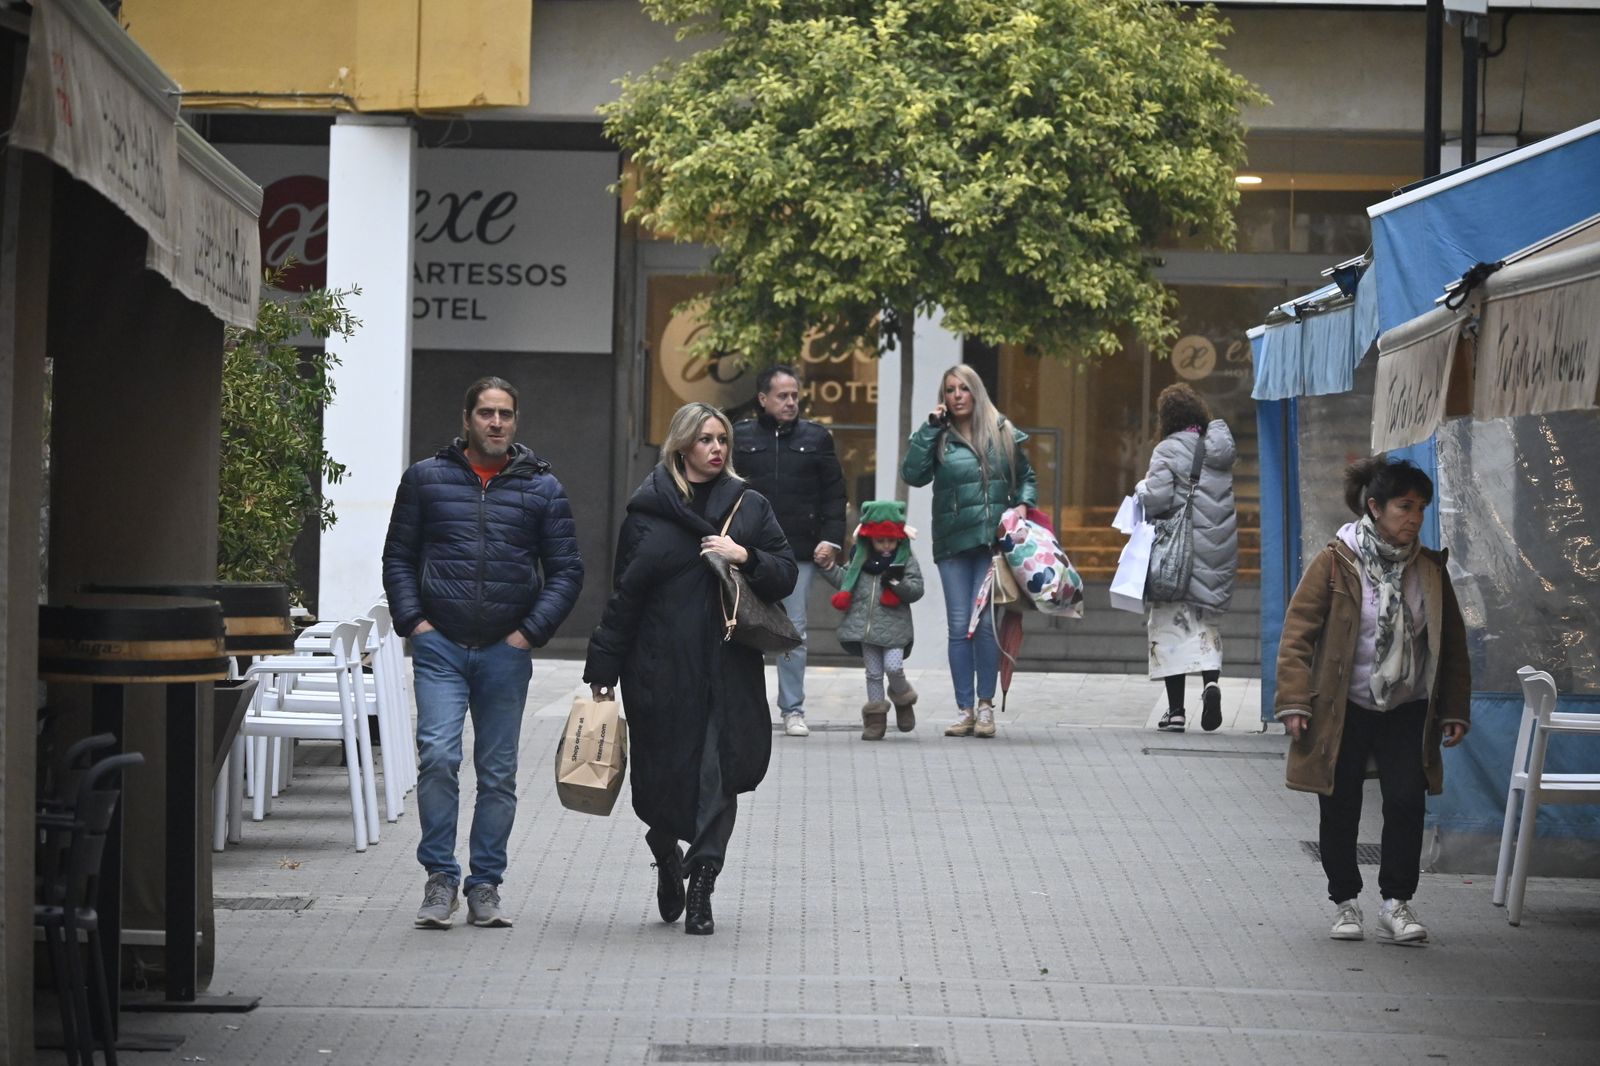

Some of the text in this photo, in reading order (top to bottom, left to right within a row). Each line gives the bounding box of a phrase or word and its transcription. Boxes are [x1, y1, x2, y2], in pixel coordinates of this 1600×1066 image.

[412, 261, 567, 287] ARTESSOS
[411, 297, 488, 321] OTEL
[799, 381, 878, 402] HOTE
